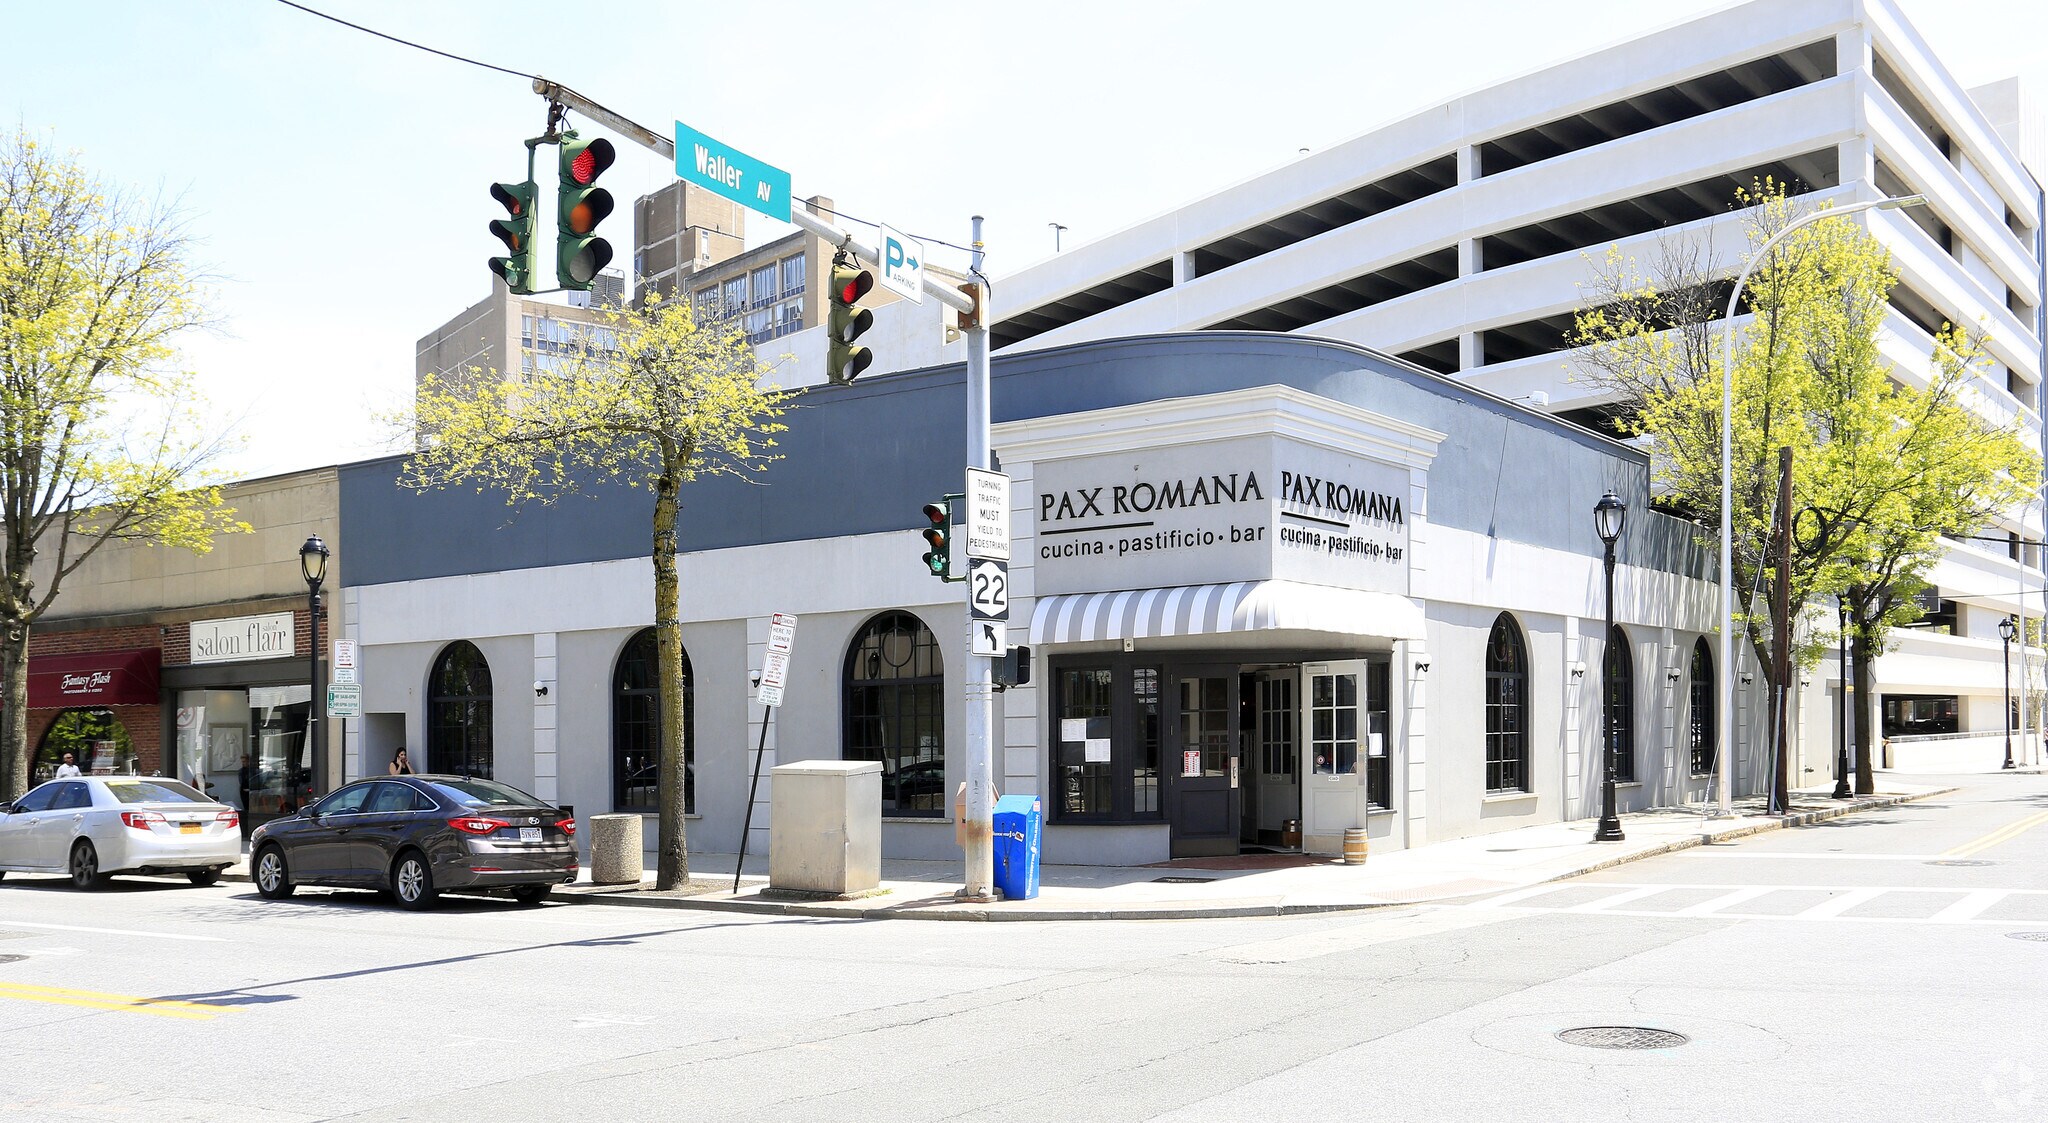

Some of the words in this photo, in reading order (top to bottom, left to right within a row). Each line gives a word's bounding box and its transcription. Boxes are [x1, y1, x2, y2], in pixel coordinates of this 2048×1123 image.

[693, 142, 743, 190] Waller
[756, 180, 772, 203] AV
[977, 478, 1002, 491] TURNING
[1040, 487, 1104, 522] PAX
[1112, 470, 1265, 515] ROMANA
[1280, 470, 1322, 508] PAX
[1326, 481, 1404, 525] ROMANA
[977, 493, 1002, 506] TRAFFIC
[979, 508, 1000, 522] MUST
[976, 524, 994, 536] YIELD
[995, 526, 1003, 537] TO
[1040, 539, 1104, 559] cucina
[1118, 528, 1220, 557] pastificio
[1230, 524, 1266, 544] bar
[1280, 525, 1321, 546] cucina
[1328, 534, 1380, 558] pastificio
[1386, 543, 1404, 560] bar
[969, 537, 1009, 552] PEDESTRIANS
[975, 572, 1005, 606] 22
[197, 626, 241, 657] salon
[246, 621, 287, 653] flair
[772, 634, 790, 643] CORNER
[61, 673, 91, 690] Fantasy
[89, 671, 112, 688] Flash
